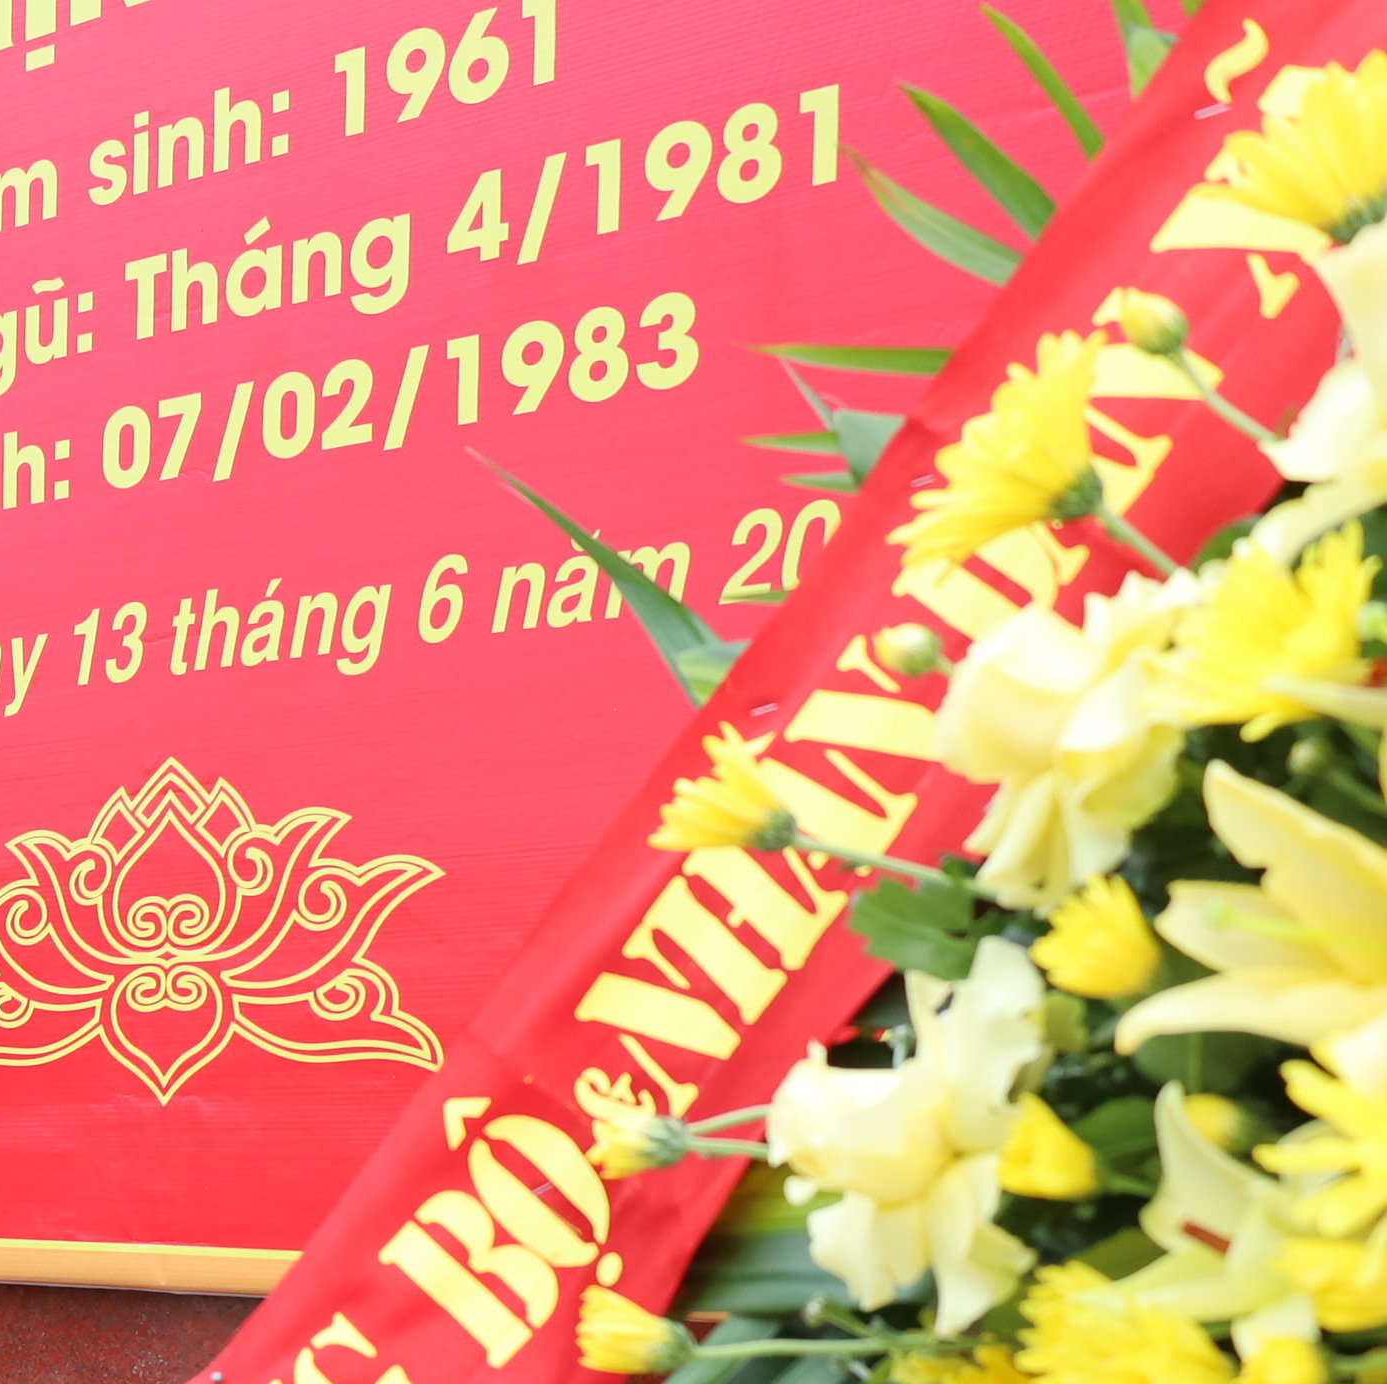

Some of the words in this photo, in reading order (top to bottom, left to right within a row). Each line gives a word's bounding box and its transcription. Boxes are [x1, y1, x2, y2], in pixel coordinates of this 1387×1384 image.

[88, 86, 290, 206] sinh:
[334, 0, 557, 137] 1961
[124, 213, 411, 340] Tháng
[446, 83, 840, 265] 4/1981
[102, 292, 699, 489] 07/02/1983
[73, 601, 148, 686] 13
[170, 578, 392, 676] tháng
[418, 554, 468, 644] 6
[377, 1096, 623, 1369] BỘ
